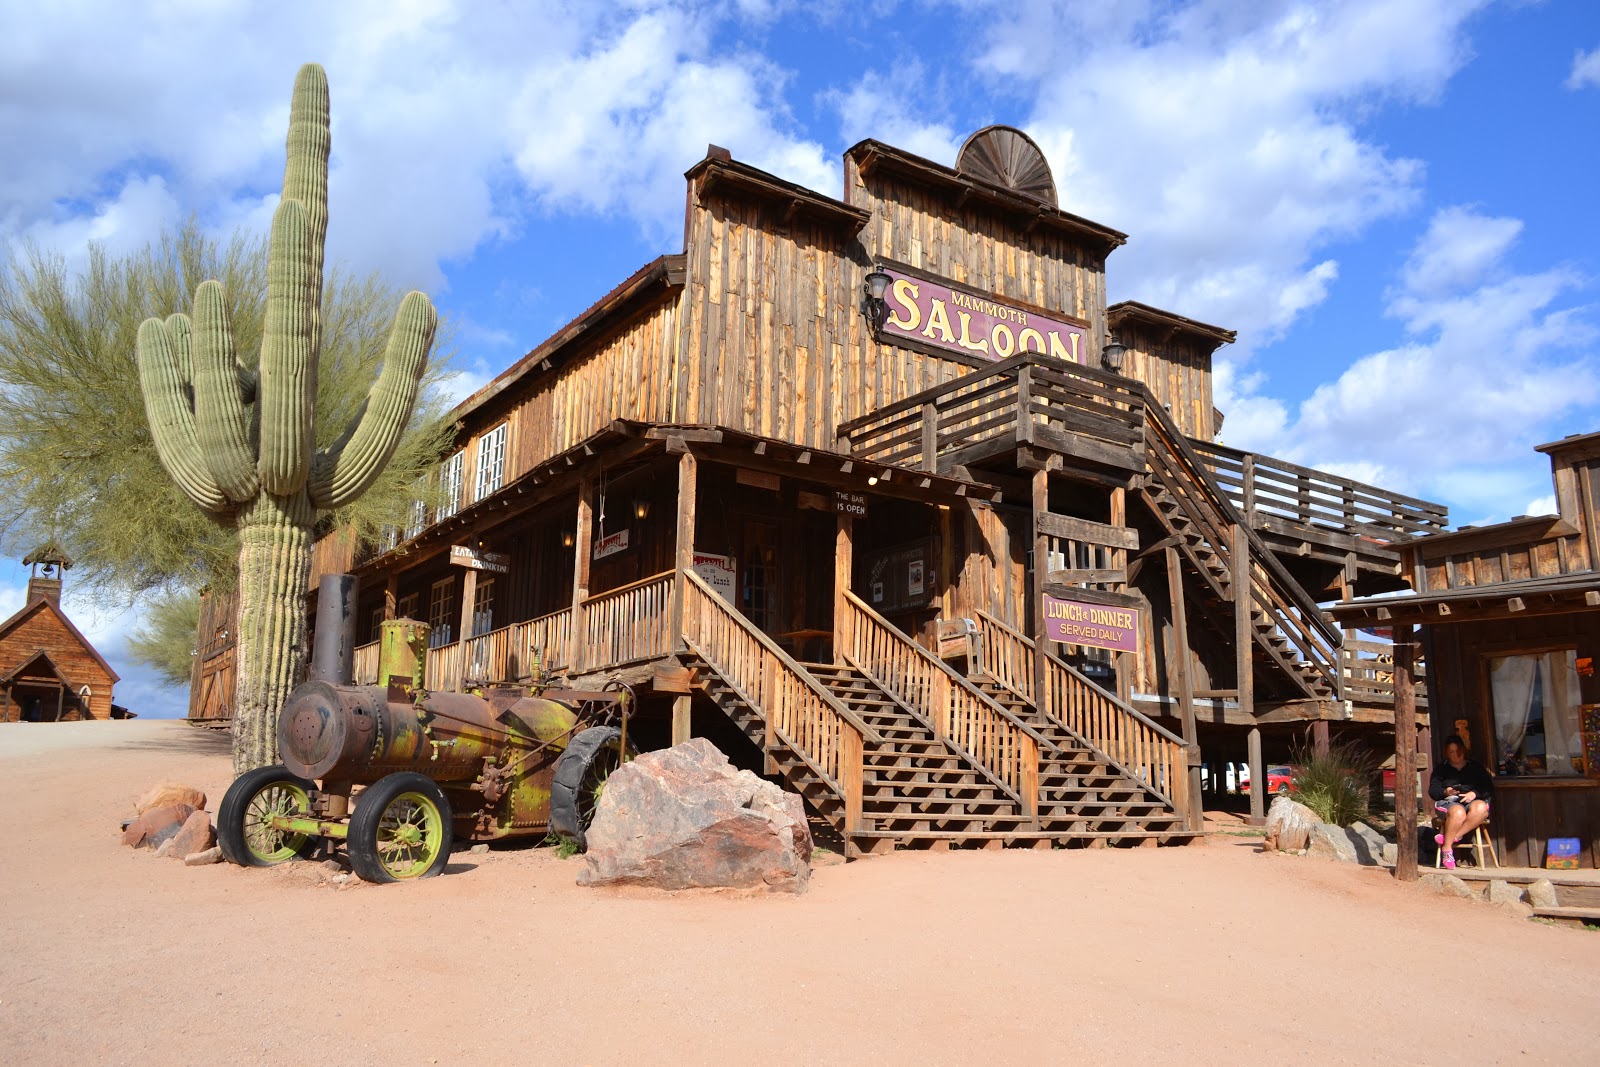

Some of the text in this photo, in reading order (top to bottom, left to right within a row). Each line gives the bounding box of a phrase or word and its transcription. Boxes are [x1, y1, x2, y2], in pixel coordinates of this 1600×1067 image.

[951, 290, 1028, 326] MAMMOTH
[886, 279, 1081, 367] SALOON
[836, 491, 865, 504] THE BAR
[837, 502, 866, 515] IS OPEN
[471, 559, 507, 573] DRINKIN
[1047, 601, 1083, 622] LUNCH
[1089, 608, 1134, 631] DINNER
[1059, 623, 1123, 642] SERVED DAILY
